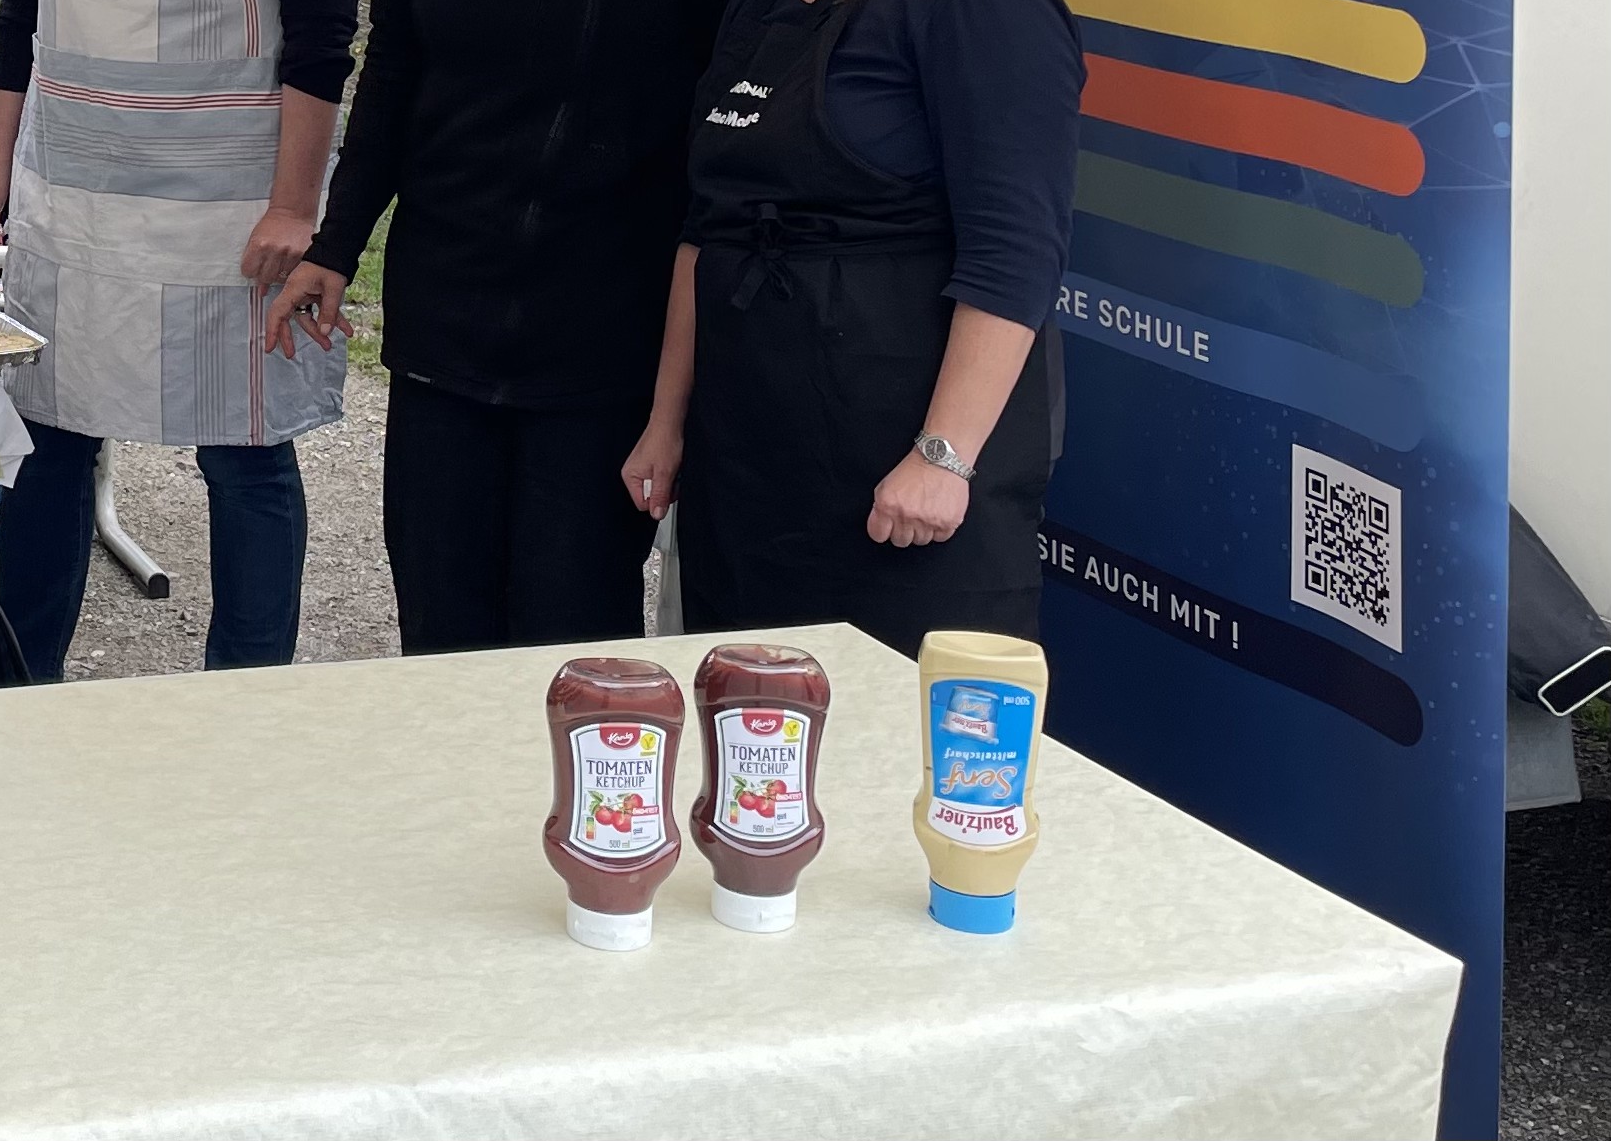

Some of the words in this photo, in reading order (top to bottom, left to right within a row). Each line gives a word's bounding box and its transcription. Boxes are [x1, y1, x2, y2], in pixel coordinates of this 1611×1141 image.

[1055, 285, 1088, 320] RE
[1098, 299, 1210, 363] SCHULE
[1036, 532, 1075, 574] SIE
[1084, 556, 1159, 613] AUCH
[1170, 593, 1221, 640] MIT
[1231, 621, 1239, 650] !
[729, 744, 797, 761] TOMATEN
[943, 747, 1017, 761] mittelscharf
[585, 759, 653, 776] TOMATEN
[739, 762, 789, 775] KETCHUP
[595, 776, 645, 789] KETCHUP
[940, 761, 1018, 799] Senf
[752, 824, 765, 833] 500
[935, 807, 1019, 836] Bautz'ner
[608, 839, 621, 849] 500
